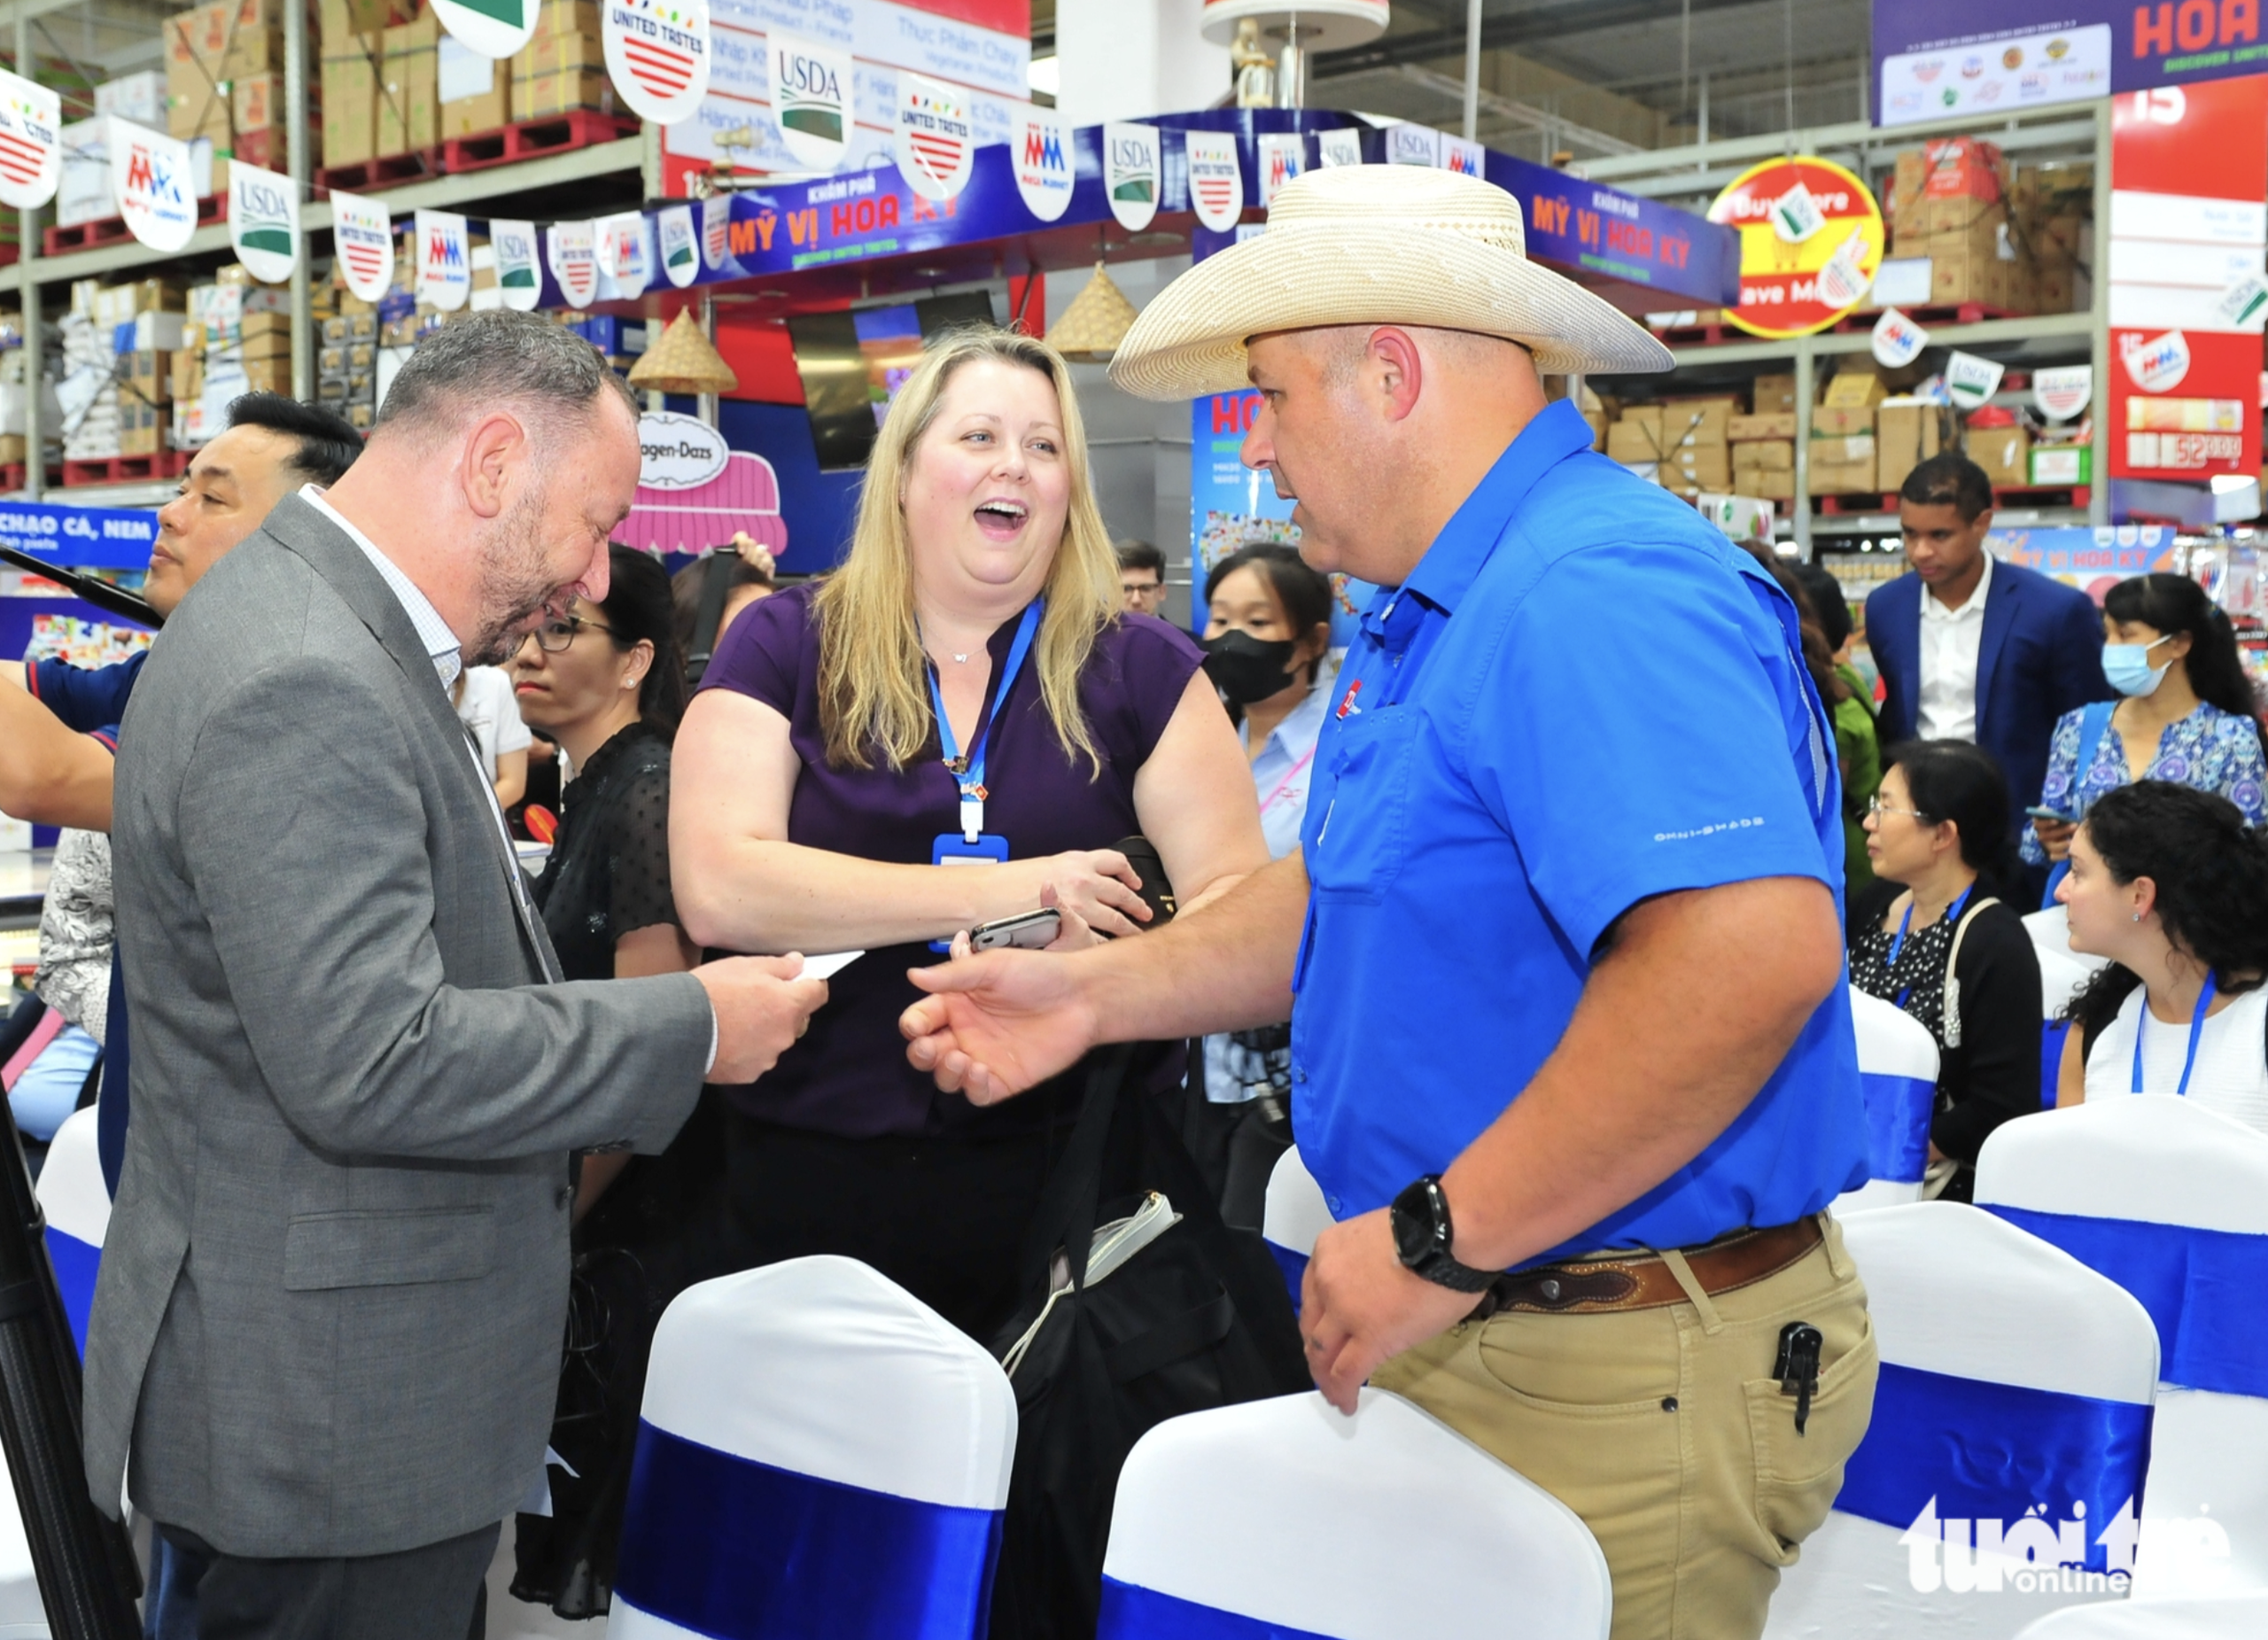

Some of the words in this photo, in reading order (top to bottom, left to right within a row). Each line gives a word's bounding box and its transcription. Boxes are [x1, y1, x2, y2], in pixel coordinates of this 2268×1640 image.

[613, 8, 656, 36] UNITED
[661, 25, 702, 54] TASTES
[2133, 0, 2259, 58] HOA
[780, 50, 842, 102] USDA
[902, 110, 935, 129] UNITED
[1112, 138, 1153, 169] USDA
[1395, 130, 1433, 158] USDA
[240, 180, 290, 222] USDA
[730, 209, 777, 255] MỸ
[787, 208, 818, 251] VỊ
[832, 193, 899, 237] HOA
[1607, 219, 1654, 260] HOA
[497, 235, 531, 260] USDA
[1741, 284, 1785, 306] ave
[103, 519, 152, 540] NEM
